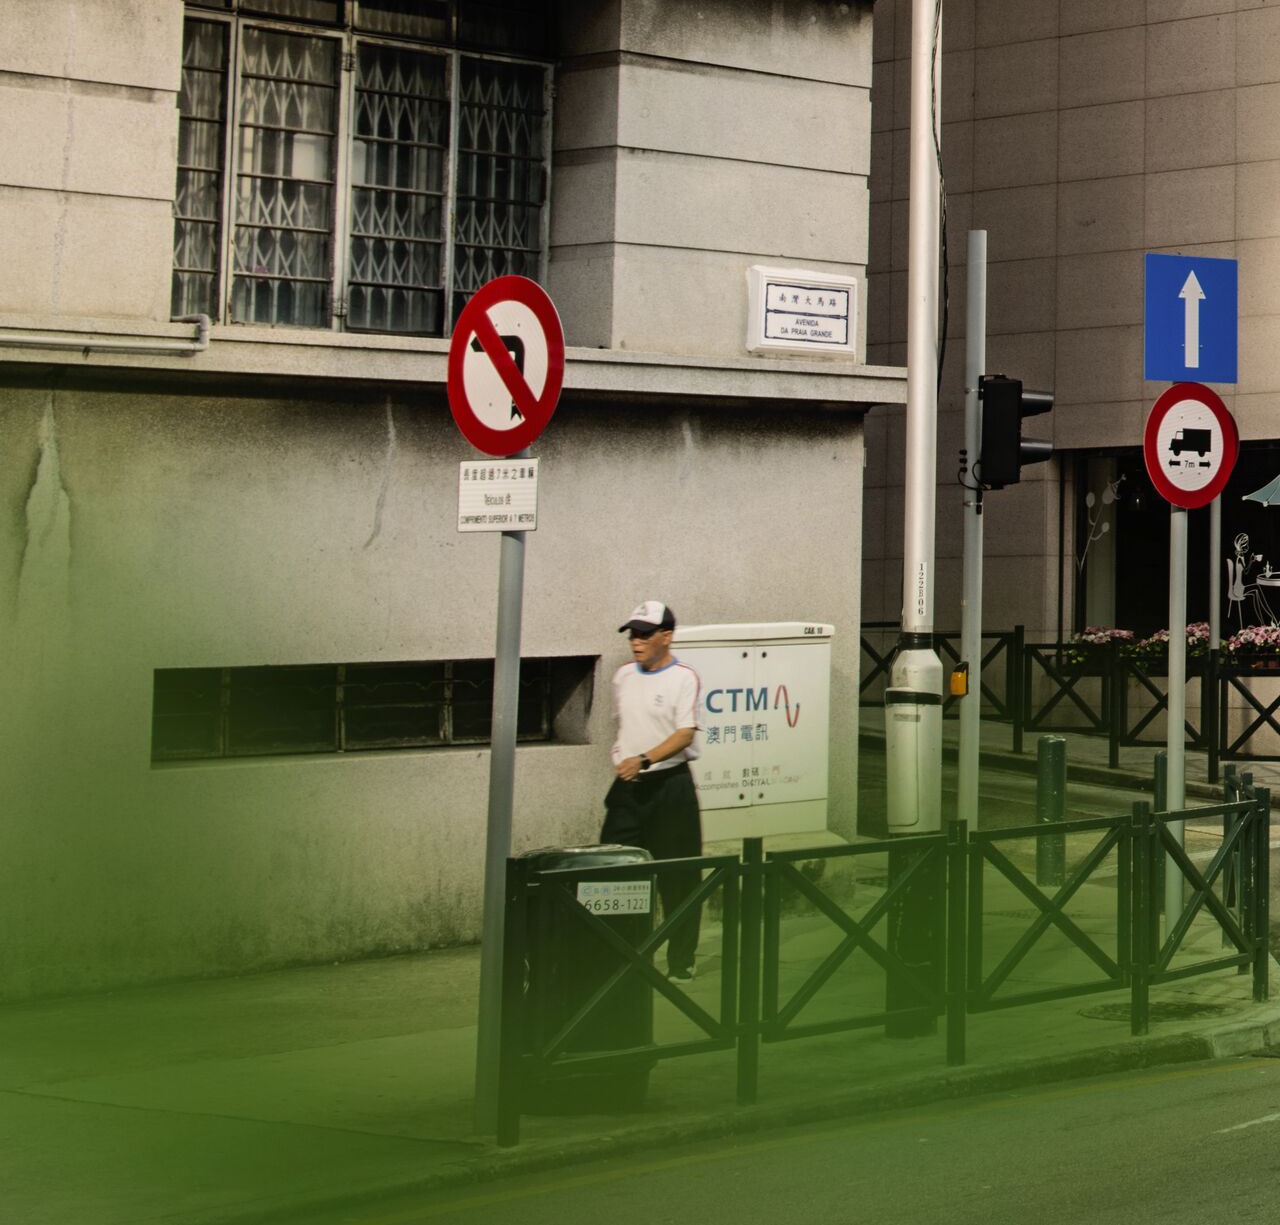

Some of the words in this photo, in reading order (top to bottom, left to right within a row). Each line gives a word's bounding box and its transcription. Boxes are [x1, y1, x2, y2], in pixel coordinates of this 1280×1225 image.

[795, 318, 819, 326] AVENIDA
[810, 329, 833, 337] GRANDE
[1184, 460, 1196, 468] 7m
[705, 687, 768, 713] CTM
[706, 724, 769, 744] 澳門電訊
